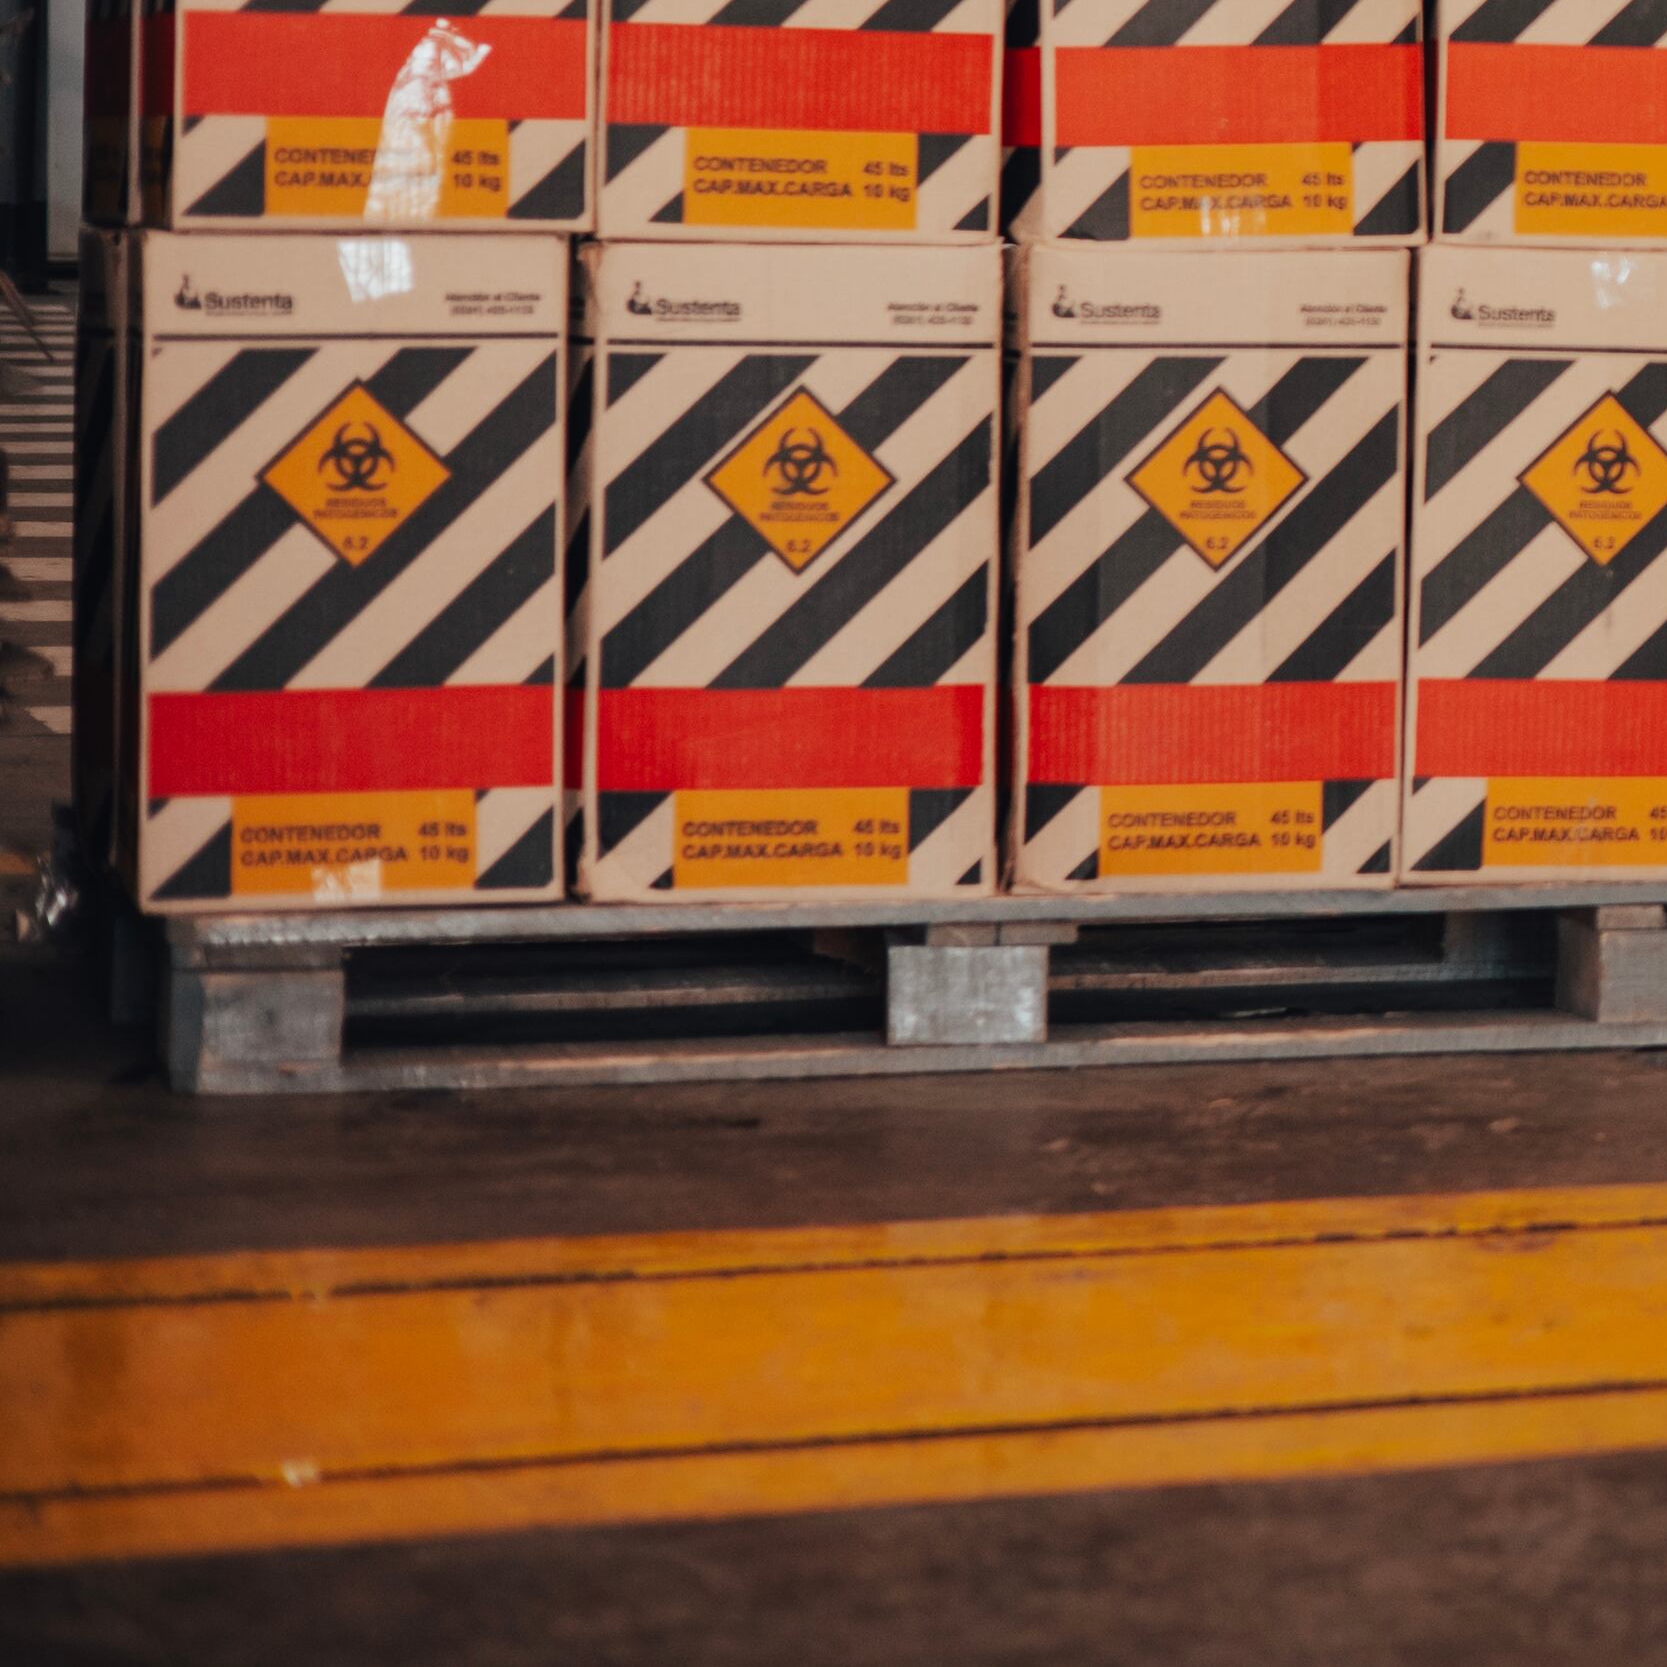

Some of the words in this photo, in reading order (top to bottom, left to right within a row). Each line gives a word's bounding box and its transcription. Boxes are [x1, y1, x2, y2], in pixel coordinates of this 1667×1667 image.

[273, 146, 376, 164] CONTENE
[449, 148, 472, 165] 45
[477, 149, 499, 165] lts
[693, 155, 829, 175] CONTENEDOR
[862, 160, 883, 176] 45
[888, 161, 909, 177] lts
[451, 172, 473, 187] 10
[478, 172, 502, 191] kg
[1138, 172, 1269, 189] CONTENEDOR
[1299, 171, 1320, 186] 45
[1324, 171, 1345, 186] lts
[1522, 169, 1648, 187] CONTENEDOR
[863, 183, 883, 198] 10
[888, 184, 911, 202] kg
[1301, 193, 1321, 208] 10
[1326, 193, 1348, 210] kg
[204, 288, 294, 310] Sustenta
[655, 296, 742, 316] Sustenta
[1079, 299, 1163, 319] Sustenta
[1477, 304, 1557, 321] Sustenta
[344, 535, 371, 551] 6.2
[786, 538, 812, 553] 6.2
[1204, 534, 1229, 549] 6.2
[1593, 536, 1617, 550] 6.2
[1107, 811, 1238, 828] CONTENEDOR
[1269, 810, 1290, 825] 45
[1294, 810, 1314, 824] lts
[1493, 805, 1618, 820] CONTENEDOR
[1648, 805, 1667, 820] 45
[239, 822, 383, 842] CONTENEDOR
[417, 821, 440, 837] 45
[444, 820, 466, 836] lts
[681, 819, 820, 836] CONTENEDOR
[853, 818, 875, 834] 45
[880, 818, 901, 834] lts
[1649, 826, 1667, 841] 10
[1270, 831, 1290, 846] 10
[1295, 831, 1316, 848] kg
[419, 844, 441, 860] 10
[446, 843, 470, 862] kg
[854, 841, 874, 857] 10
[880, 841, 903, 860] kg
